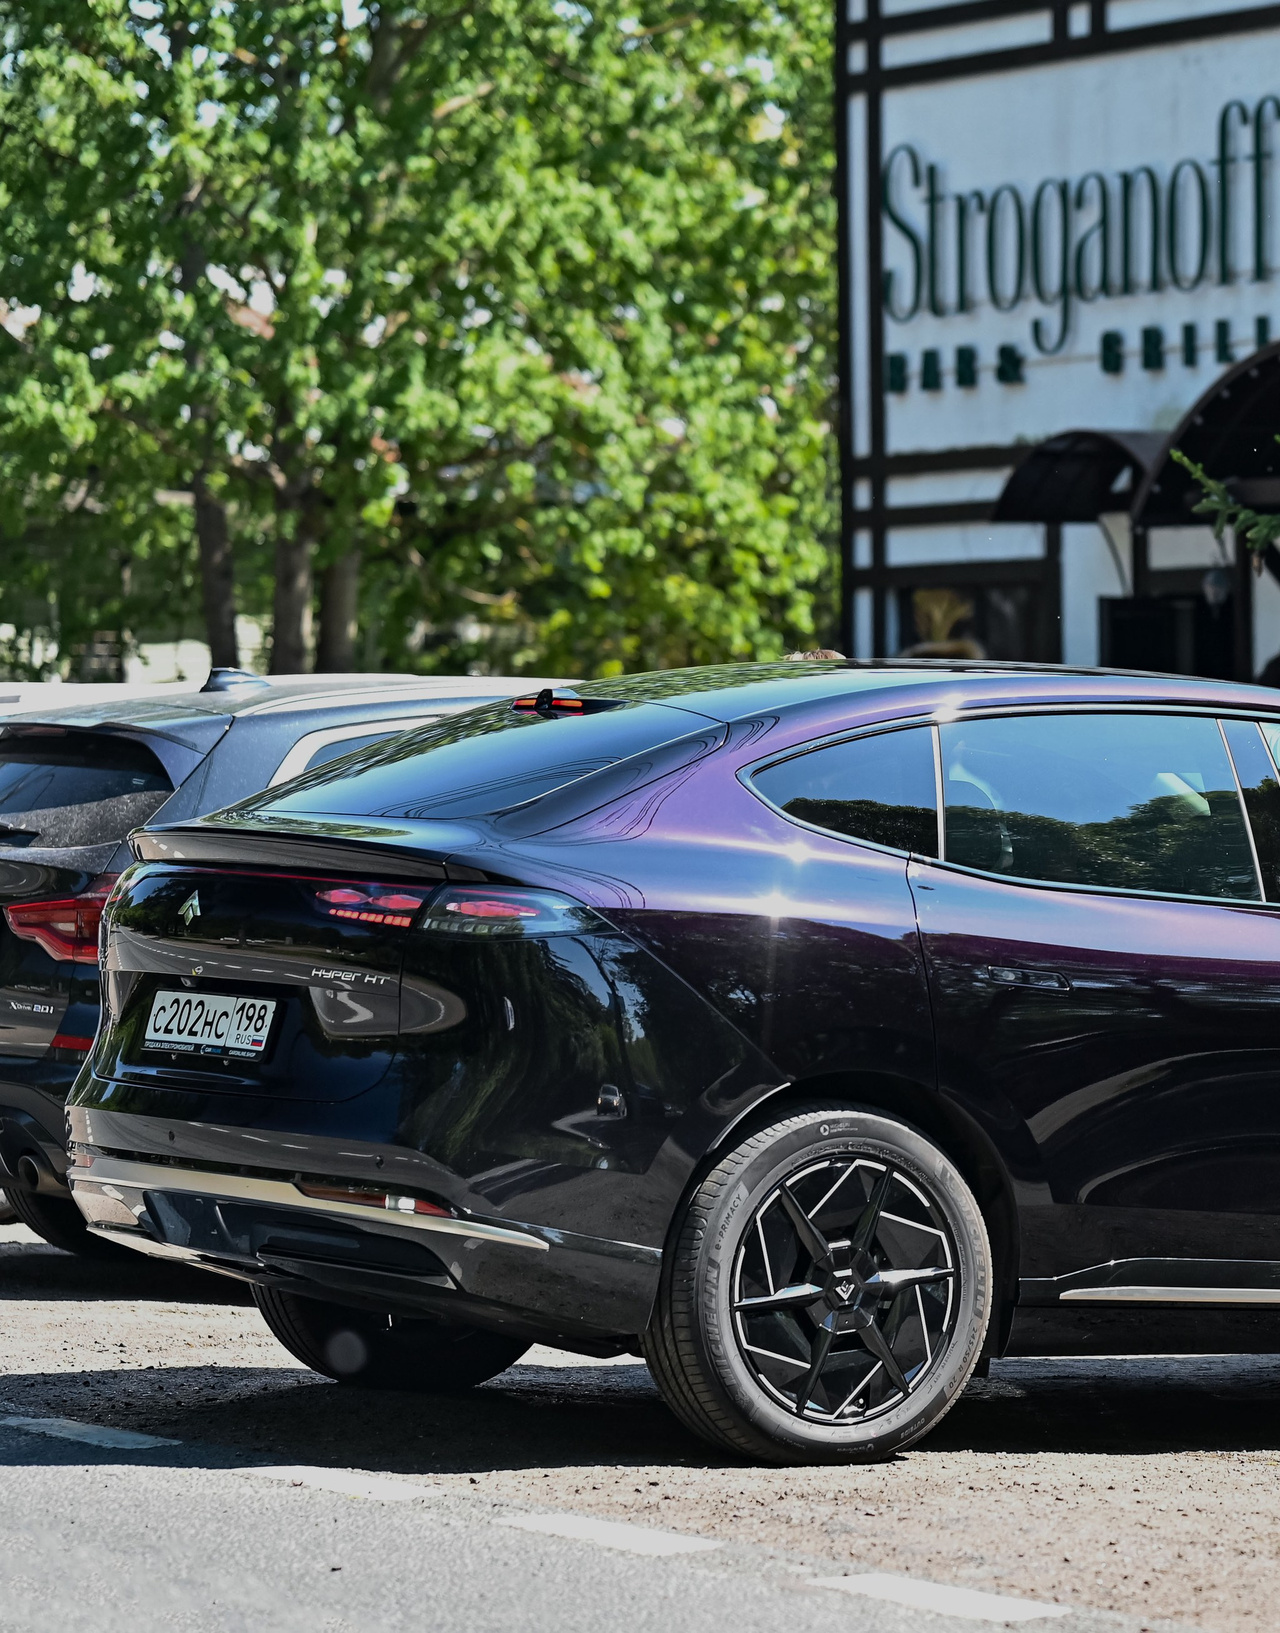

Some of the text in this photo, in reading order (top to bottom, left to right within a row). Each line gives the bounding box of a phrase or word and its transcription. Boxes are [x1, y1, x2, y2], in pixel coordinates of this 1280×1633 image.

[363, 974, 391, 985] HT
[235, 1001, 268, 1033] 198
[234, 1033, 252, 1045] RUS
[958, 1199, 986, 1317] MICHELIN
[705, 1264, 736, 1387] MICHELIN
